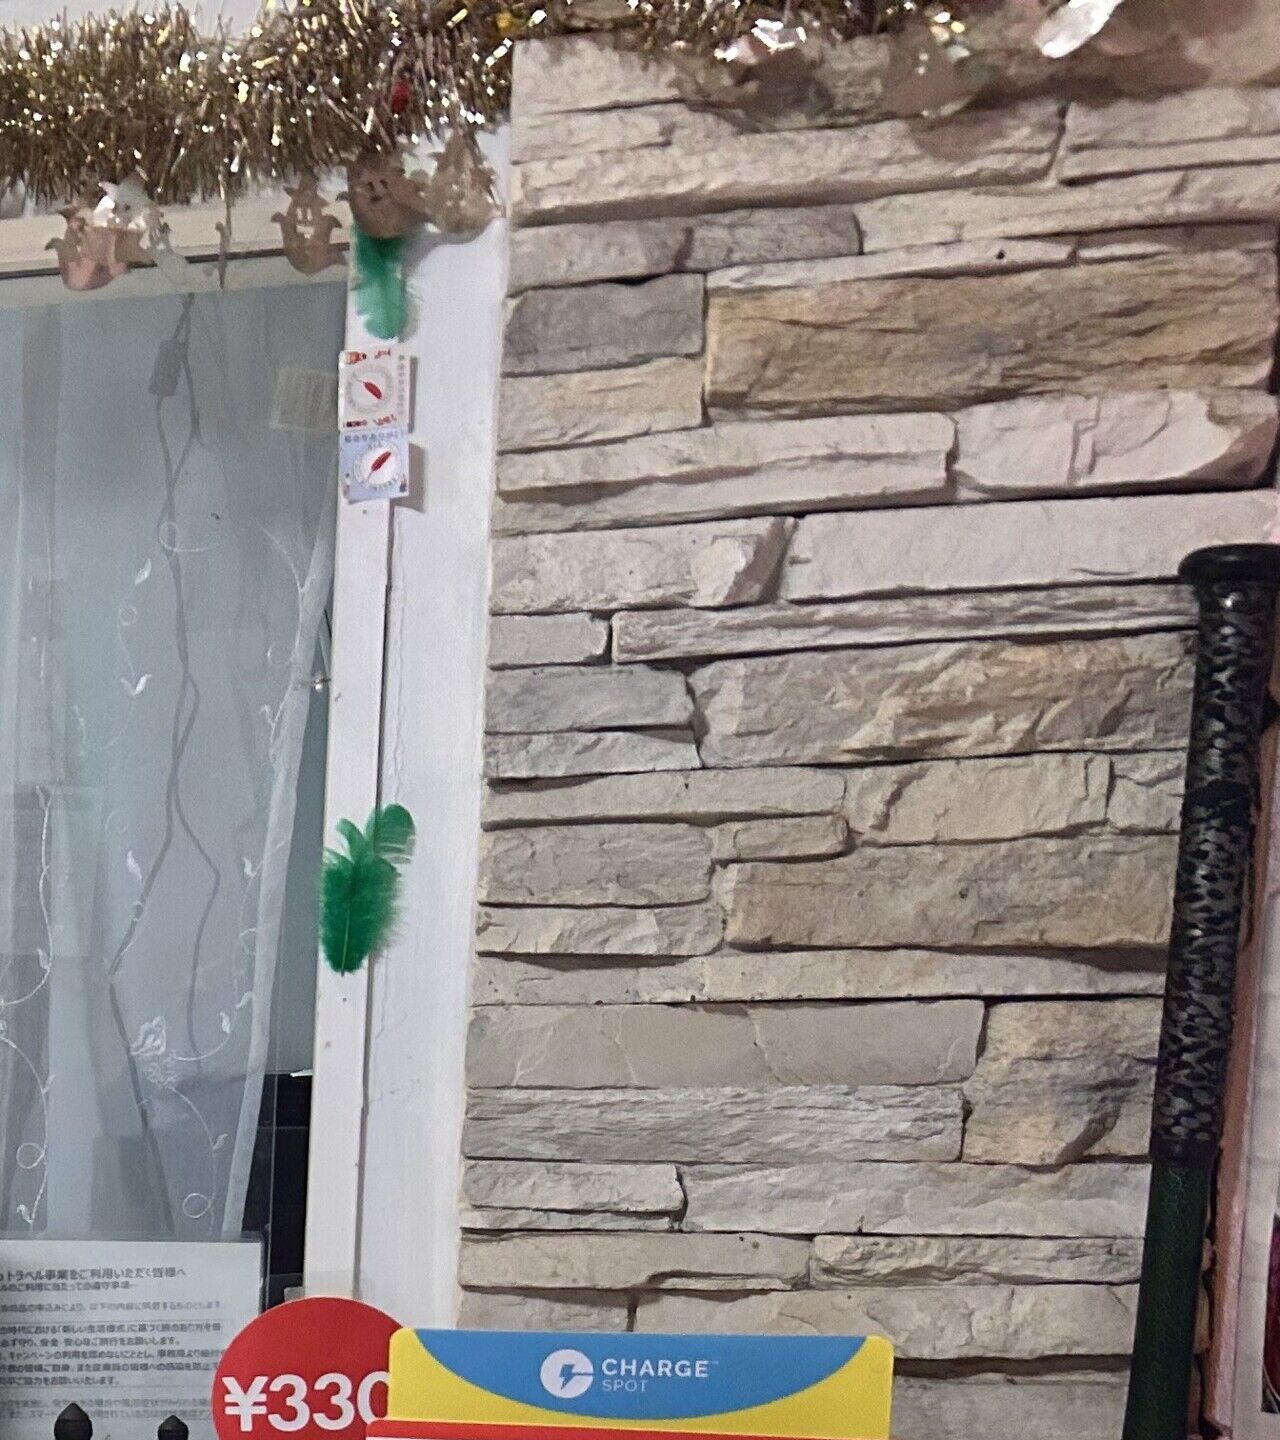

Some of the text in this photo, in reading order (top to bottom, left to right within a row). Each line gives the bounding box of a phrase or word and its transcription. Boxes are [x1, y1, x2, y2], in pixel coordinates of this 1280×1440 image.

[601, 1358, 710, 1377] CHARGE
[601, 1378, 648, 1392] SPOT
[222, 1370, 389, 1433] ¥330
